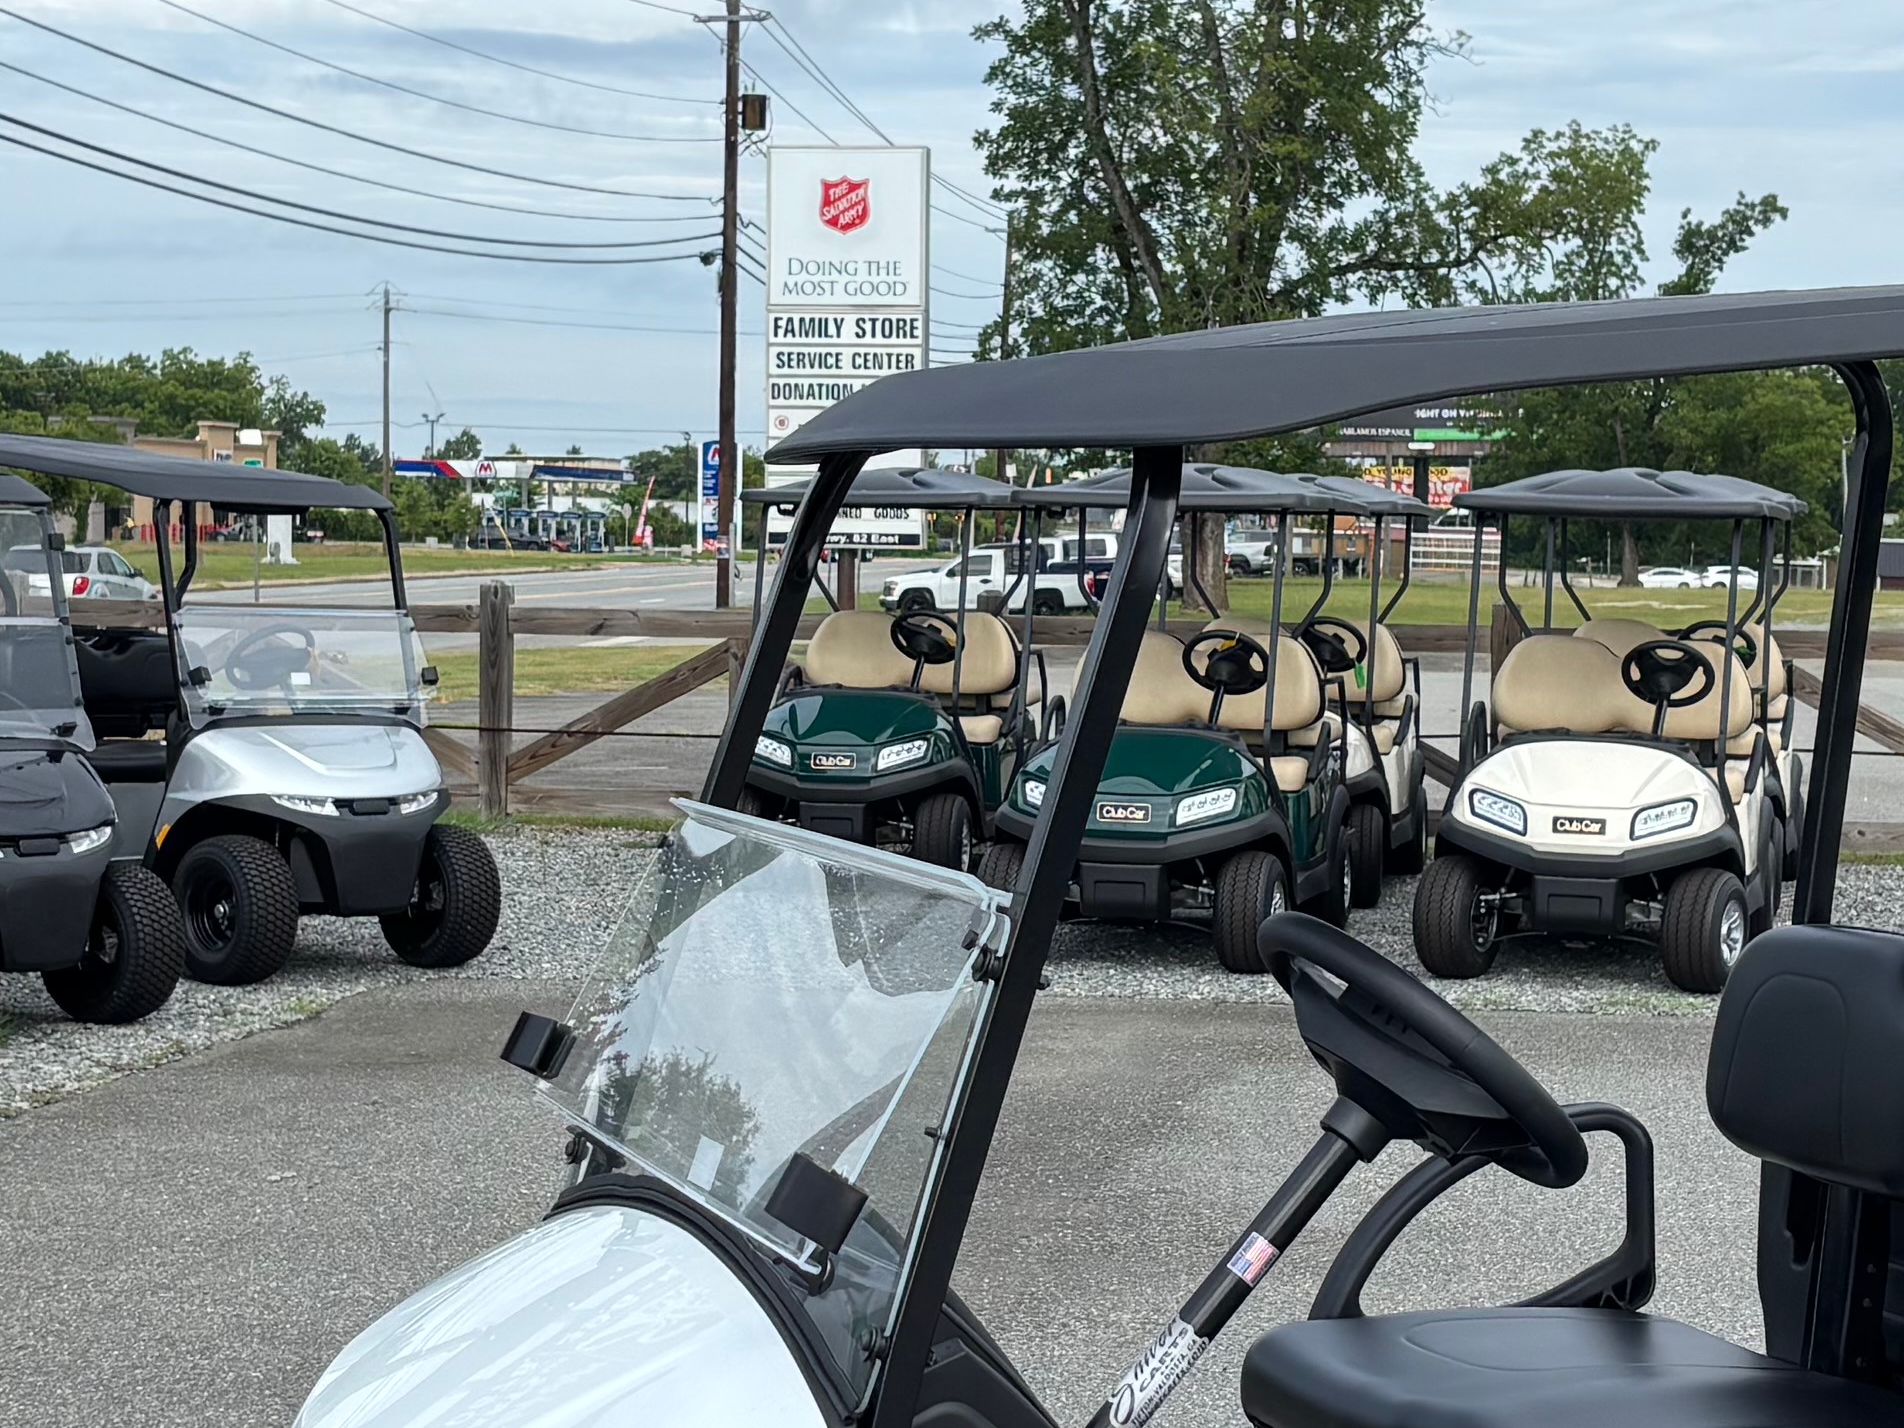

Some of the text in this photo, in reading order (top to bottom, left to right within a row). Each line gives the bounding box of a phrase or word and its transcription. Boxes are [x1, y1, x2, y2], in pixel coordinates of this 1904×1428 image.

[788, 258, 902, 276] DOING THE
[782, 281, 907, 296] MOST GOOD
[773, 317, 920, 339] FAMILY STORE
[776, 352, 915, 370] SERVICE CENTER
[771, 383, 853, 400] DONATION
[1139, 1327, 1188, 1393] CARTS
